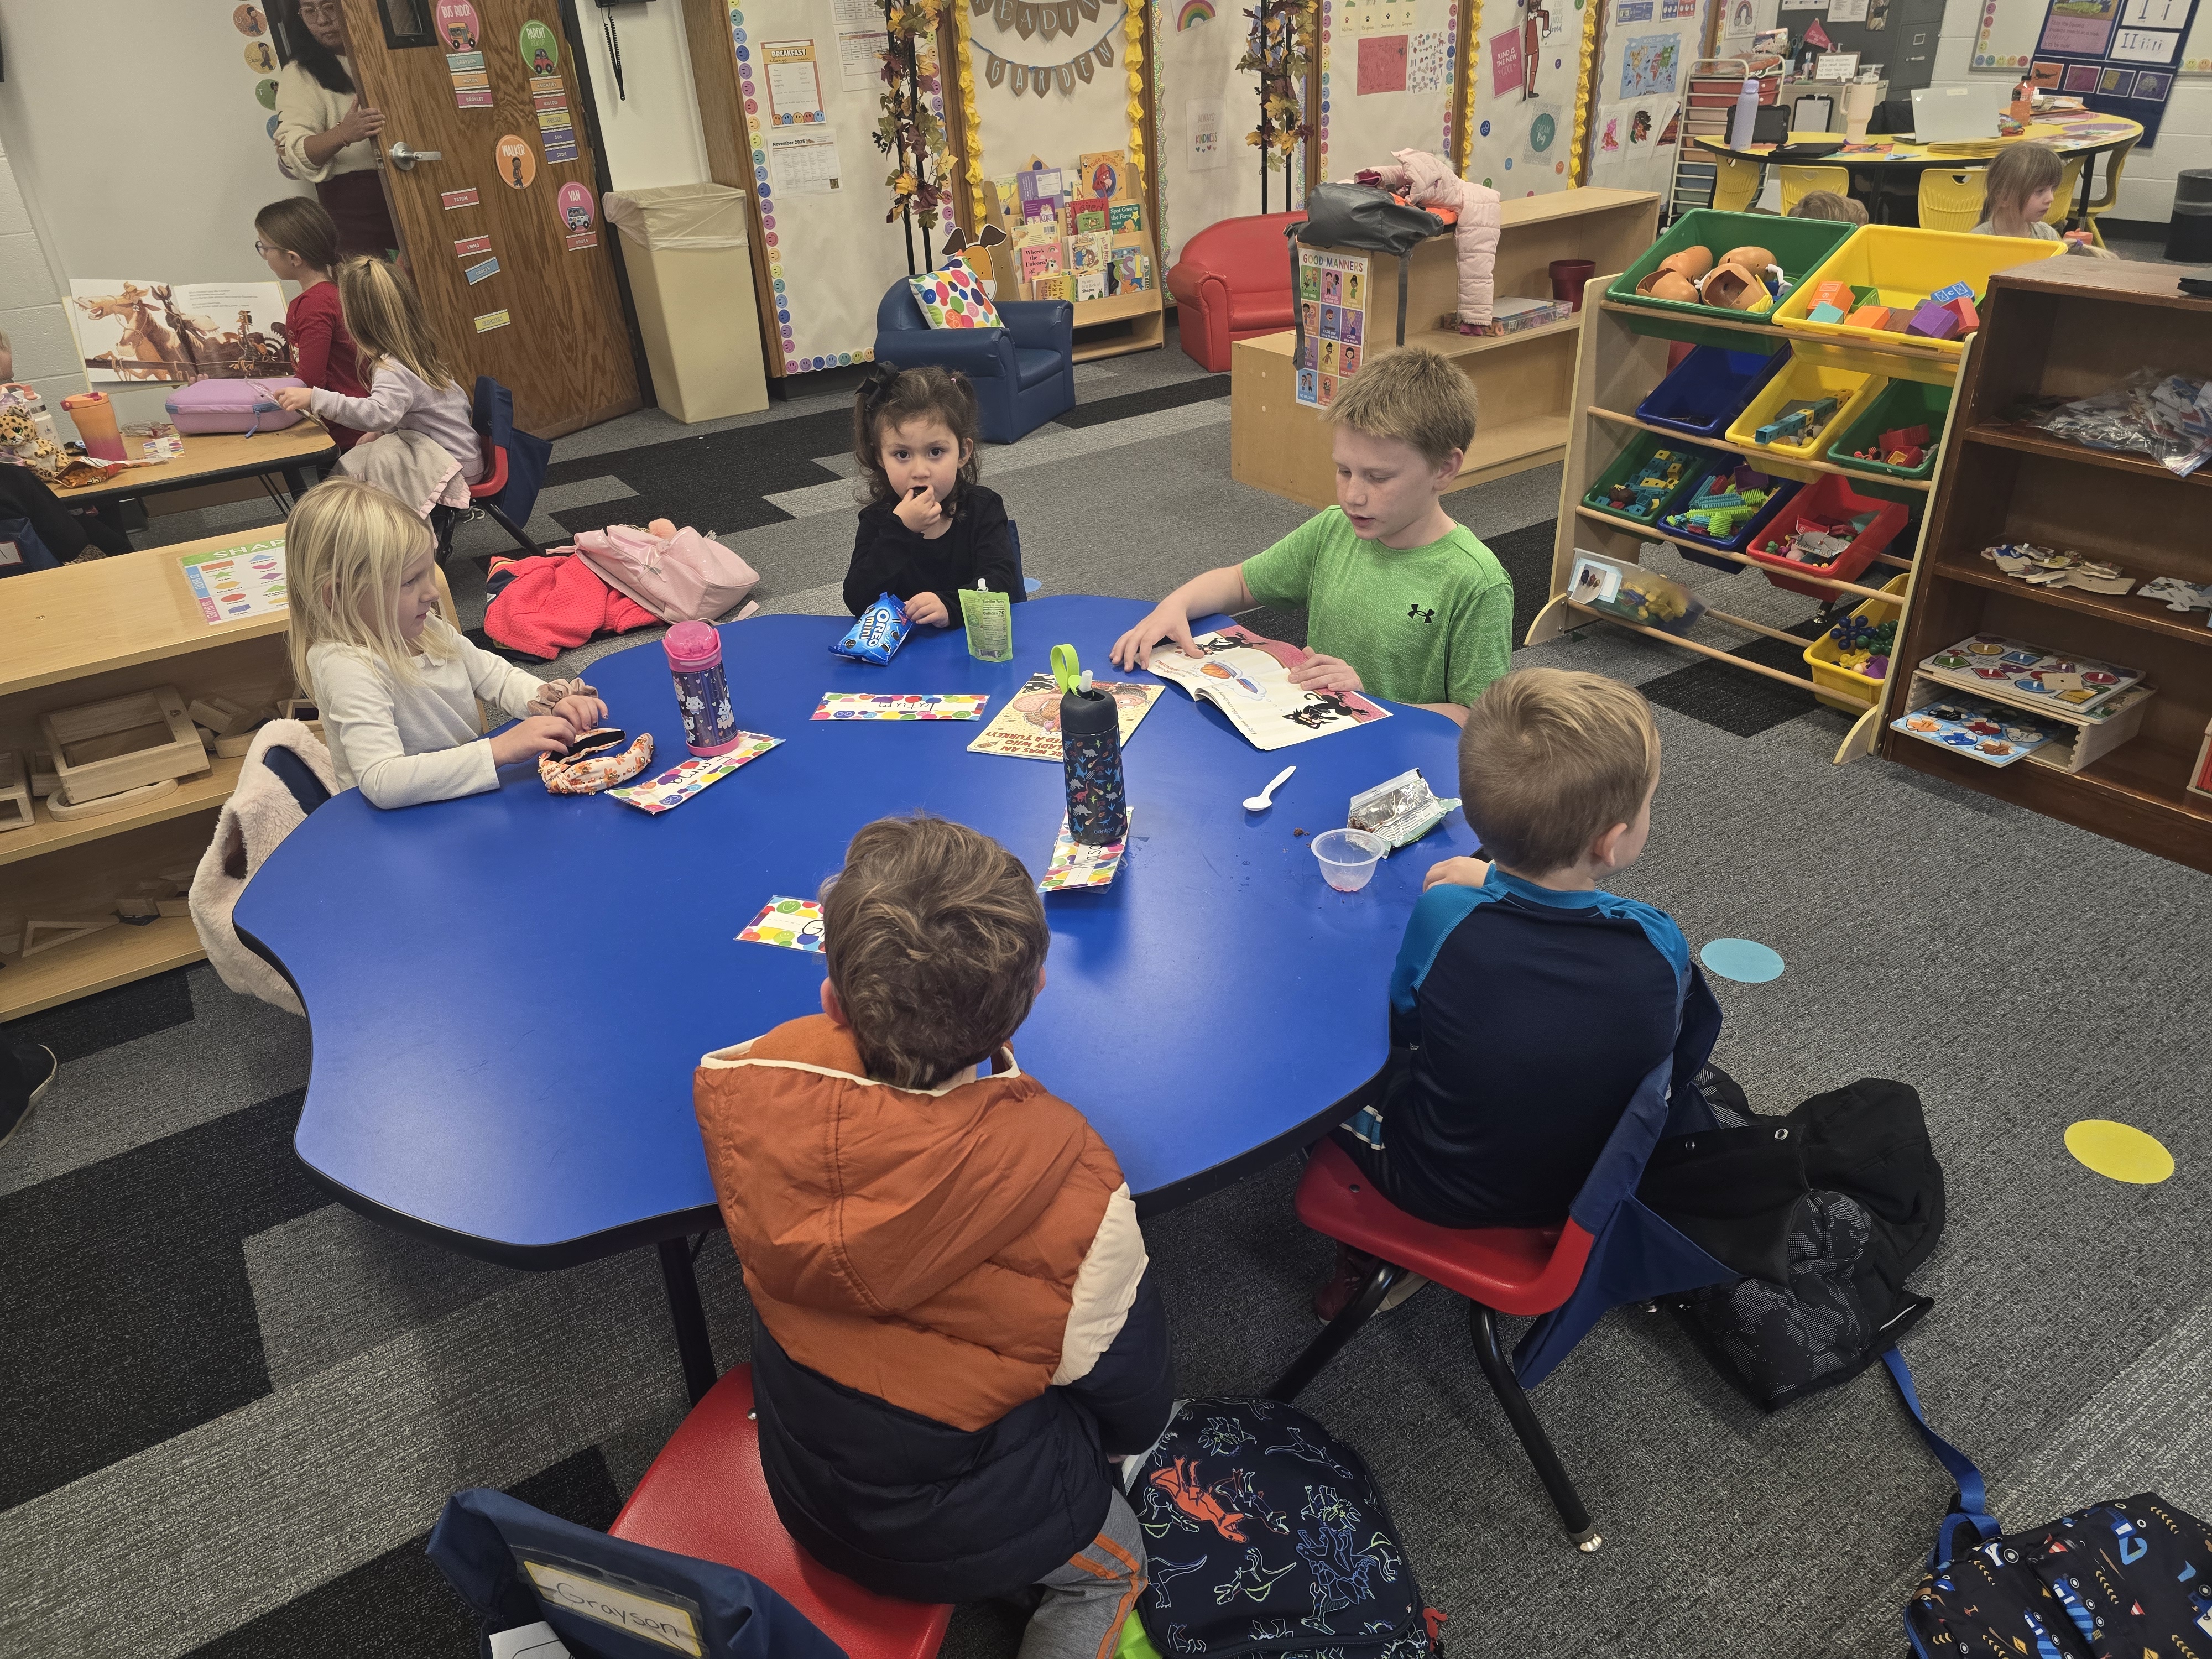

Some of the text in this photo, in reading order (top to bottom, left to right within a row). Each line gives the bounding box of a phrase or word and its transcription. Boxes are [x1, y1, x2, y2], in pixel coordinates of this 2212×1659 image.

[441, 4, 471, 18] BUS RIDER
[975, 0, 1097, 29] EADIN
[526, 27, 545, 40] PARENT
[771, 49, 806, 58] BREAKFAST
[1496, 53, 1517, 67] THE NEW
[1498, 49, 1510, 60] KIND
[992, 43, 1111, 91] GARDEN
[1501, 65, 1513, 76] COOL
[1198, 112, 1215, 123] ALWAYS
[1196, 132, 1217, 144] KINDNESS
[502, 144, 525, 157] WALKER
[568, 190, 581, 202] VAN
[1026, 259, 1047, 267] Unicorn?
[1303, 254, 1363, 272] GOOD MANNERS
[213, 539, 285, 558] SHAP
[192, 578, 205, 590] SHAPES
[204, 606, 218, 619] SHAPES
[860, 617, 875, 639] mini
[867, 609, 889, 646] OREO
[879, 702, 938, 711] Tatum
[985, 731, 1032, 740] TURKEY!
[669, 755, 733, 784] Emma
[1071, 844, 1102, 869] Maso
[556, 1582, 681, 1639] Grayson
